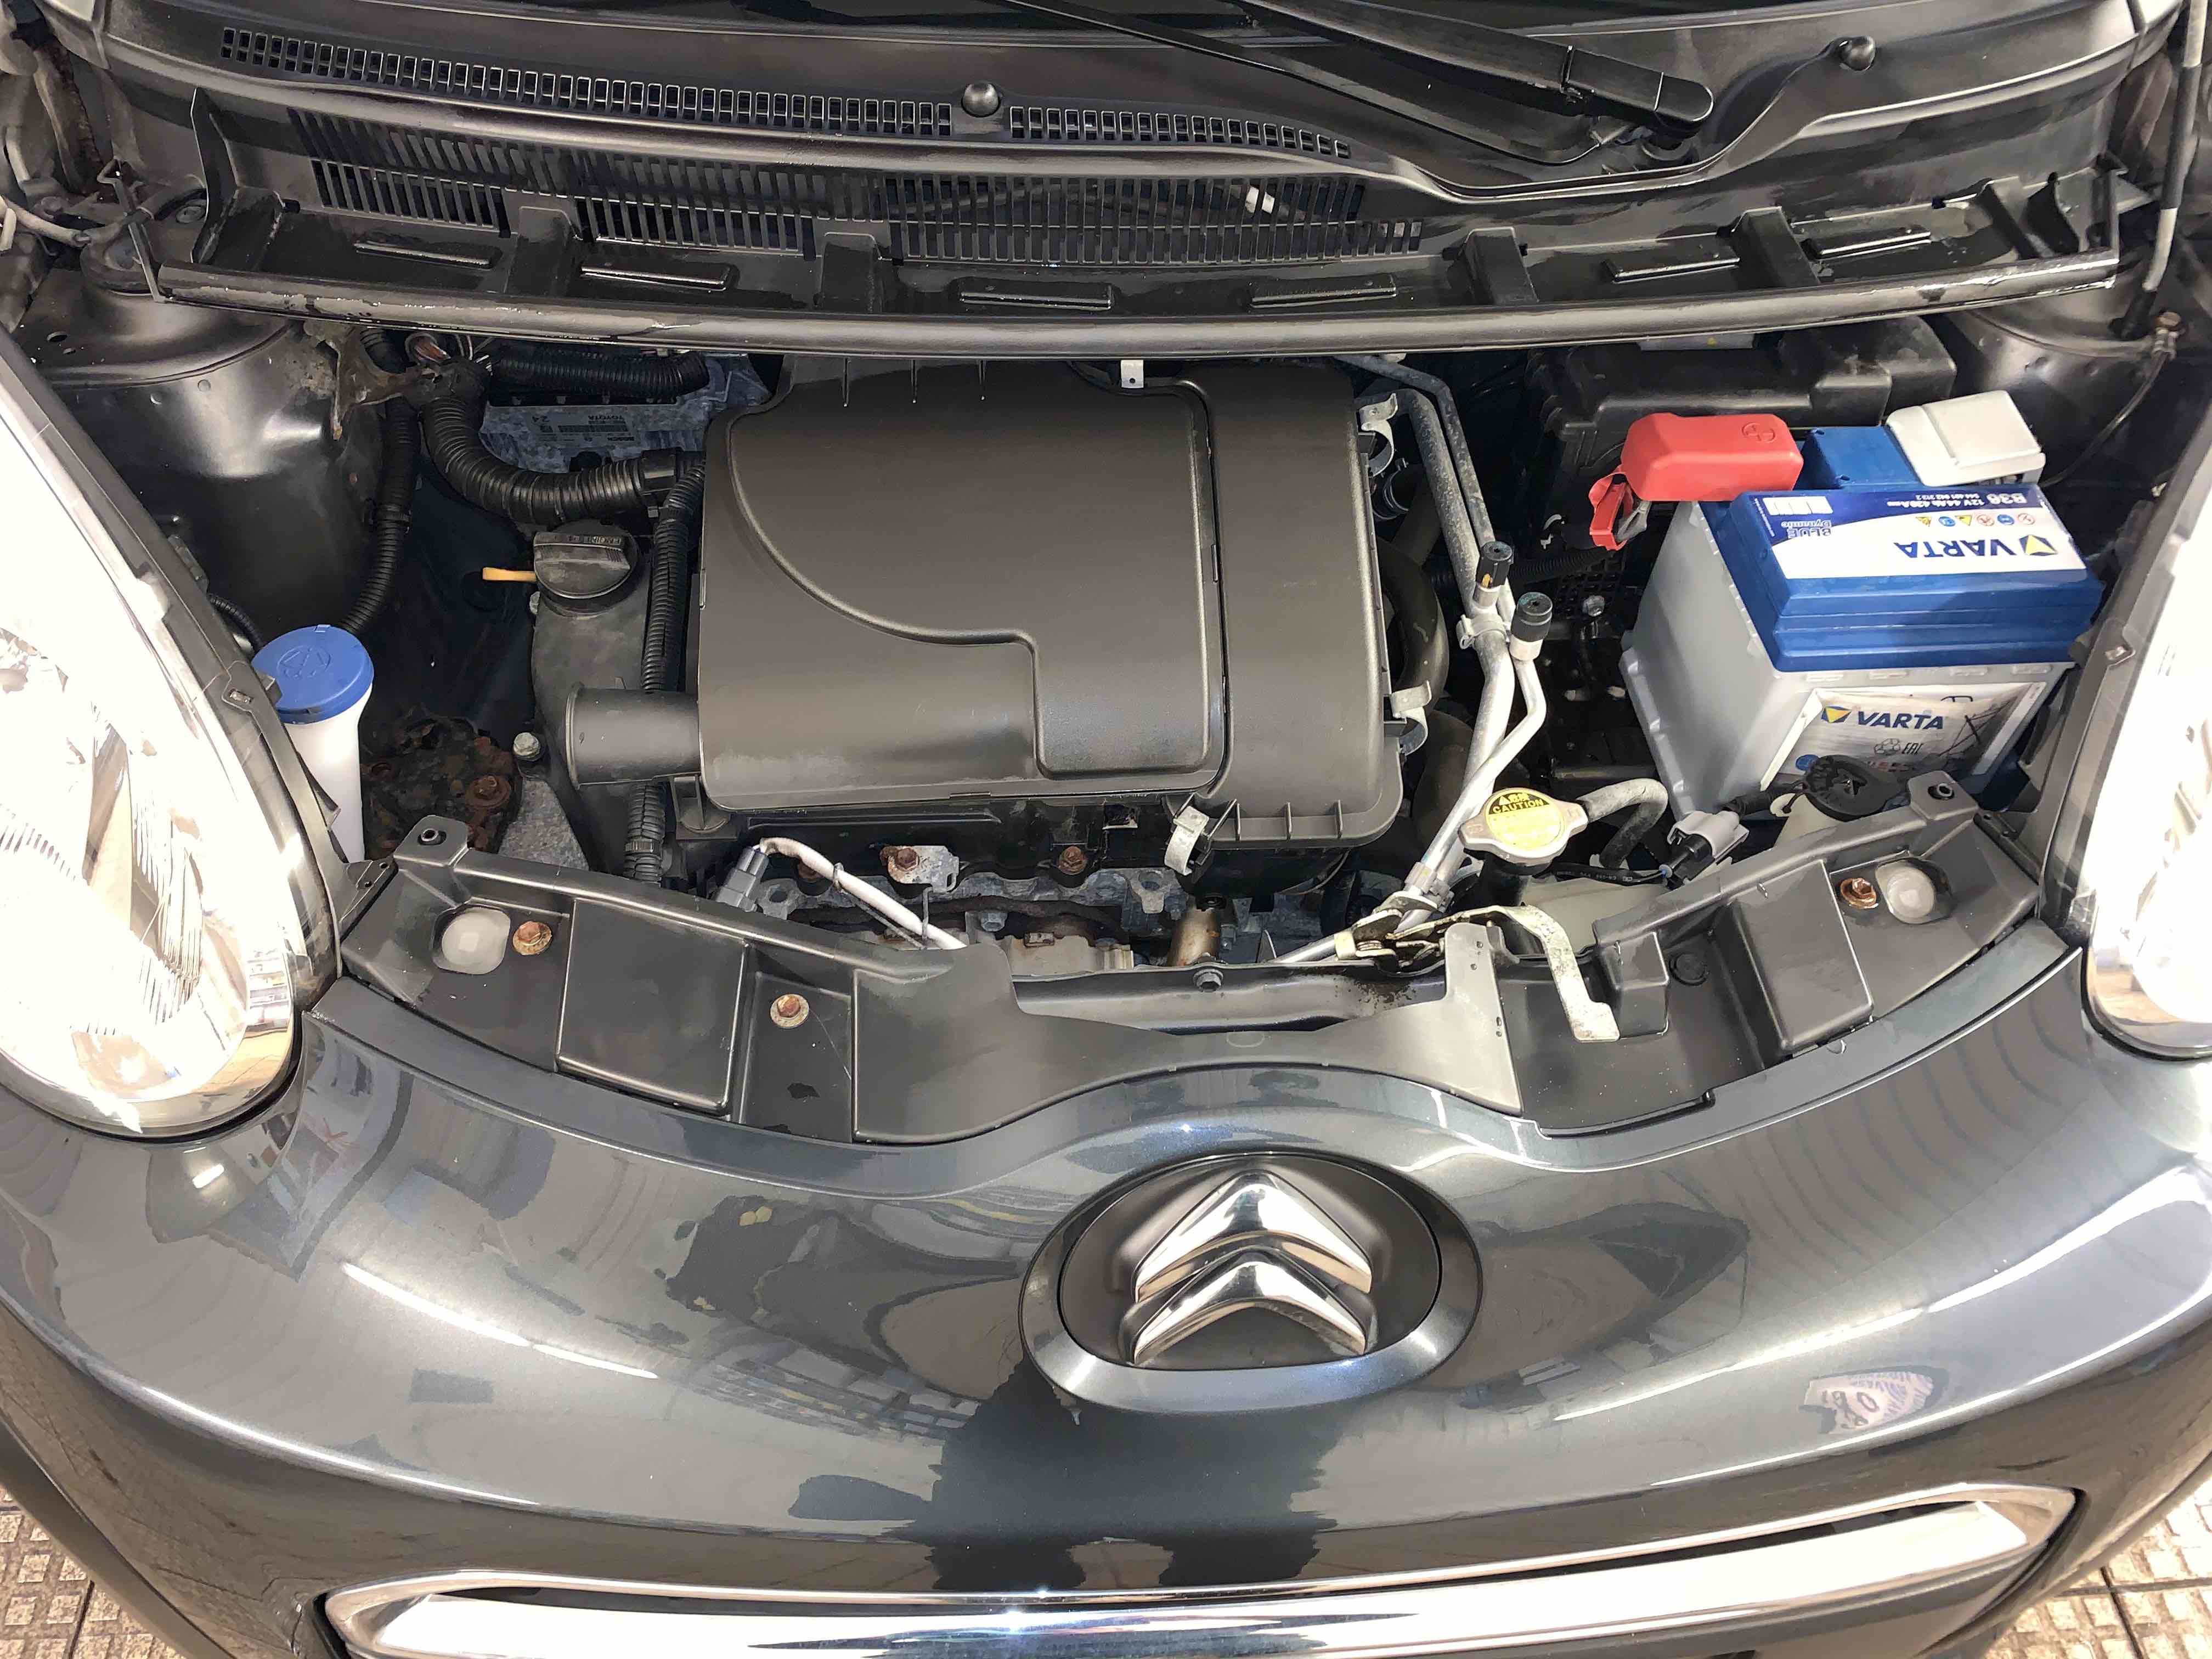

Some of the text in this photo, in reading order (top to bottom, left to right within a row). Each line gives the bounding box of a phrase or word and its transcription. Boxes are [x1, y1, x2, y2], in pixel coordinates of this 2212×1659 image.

[1781, 519, 1832, 528] Dynamic
[1787, 527, 1831, 539] BLUE
[1894, 539, 2017, 558] VARTA
[1857, 710, 1944, 730] VARTA
[1493, 799, 1544, 813] CAUTION
